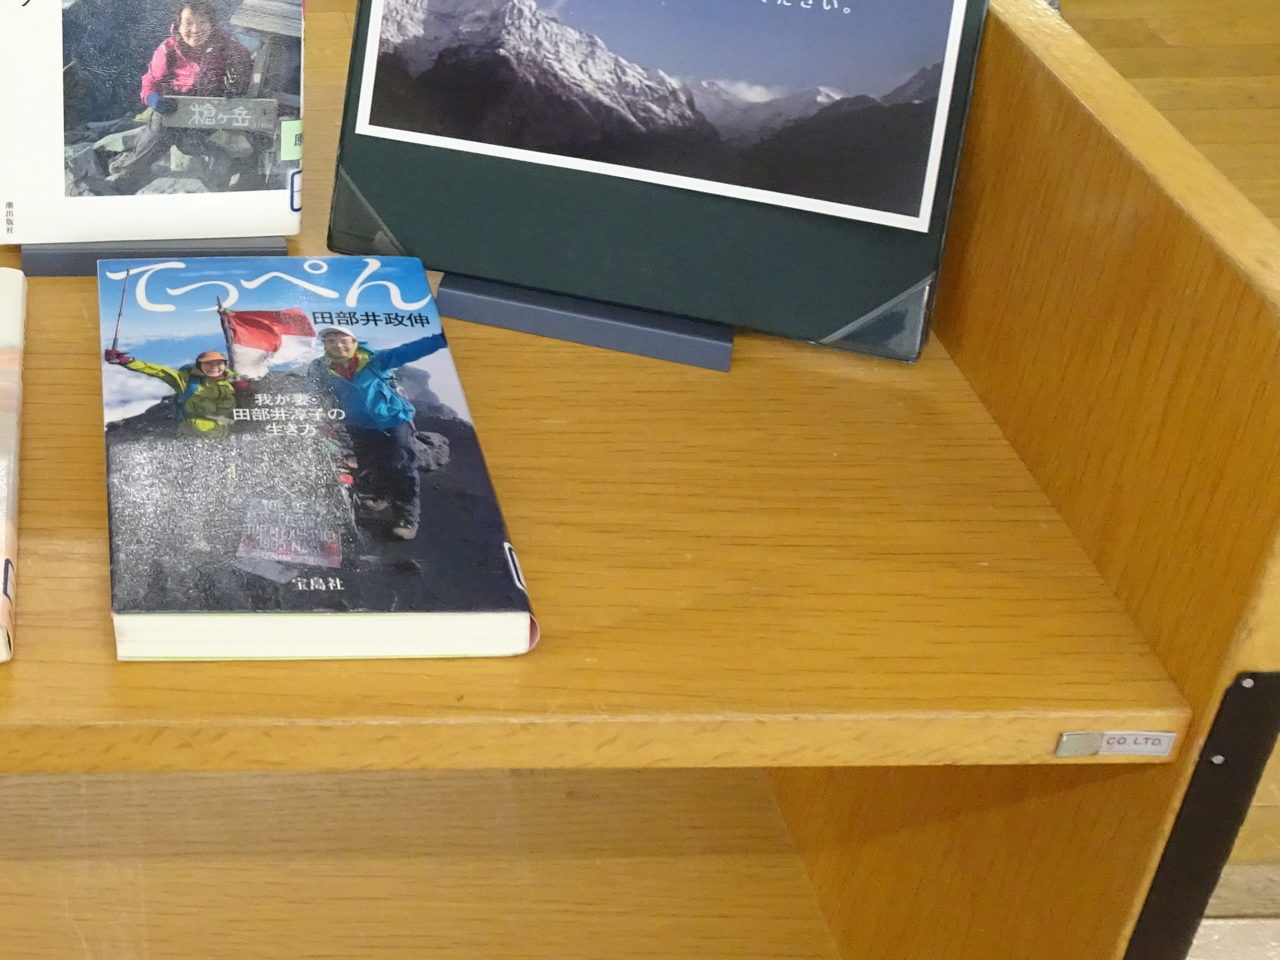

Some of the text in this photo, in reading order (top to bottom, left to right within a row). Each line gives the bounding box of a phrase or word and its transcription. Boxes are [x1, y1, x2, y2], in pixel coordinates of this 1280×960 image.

[105, 257, 432, 313] てっぺん
[312, 310, 431, 329] 田部井政伸
[232, 406, 346, 422] 田部井淳子の
[265, 422, 317, 436] 生き方
[292, 577, 344, 591] 宝島社
